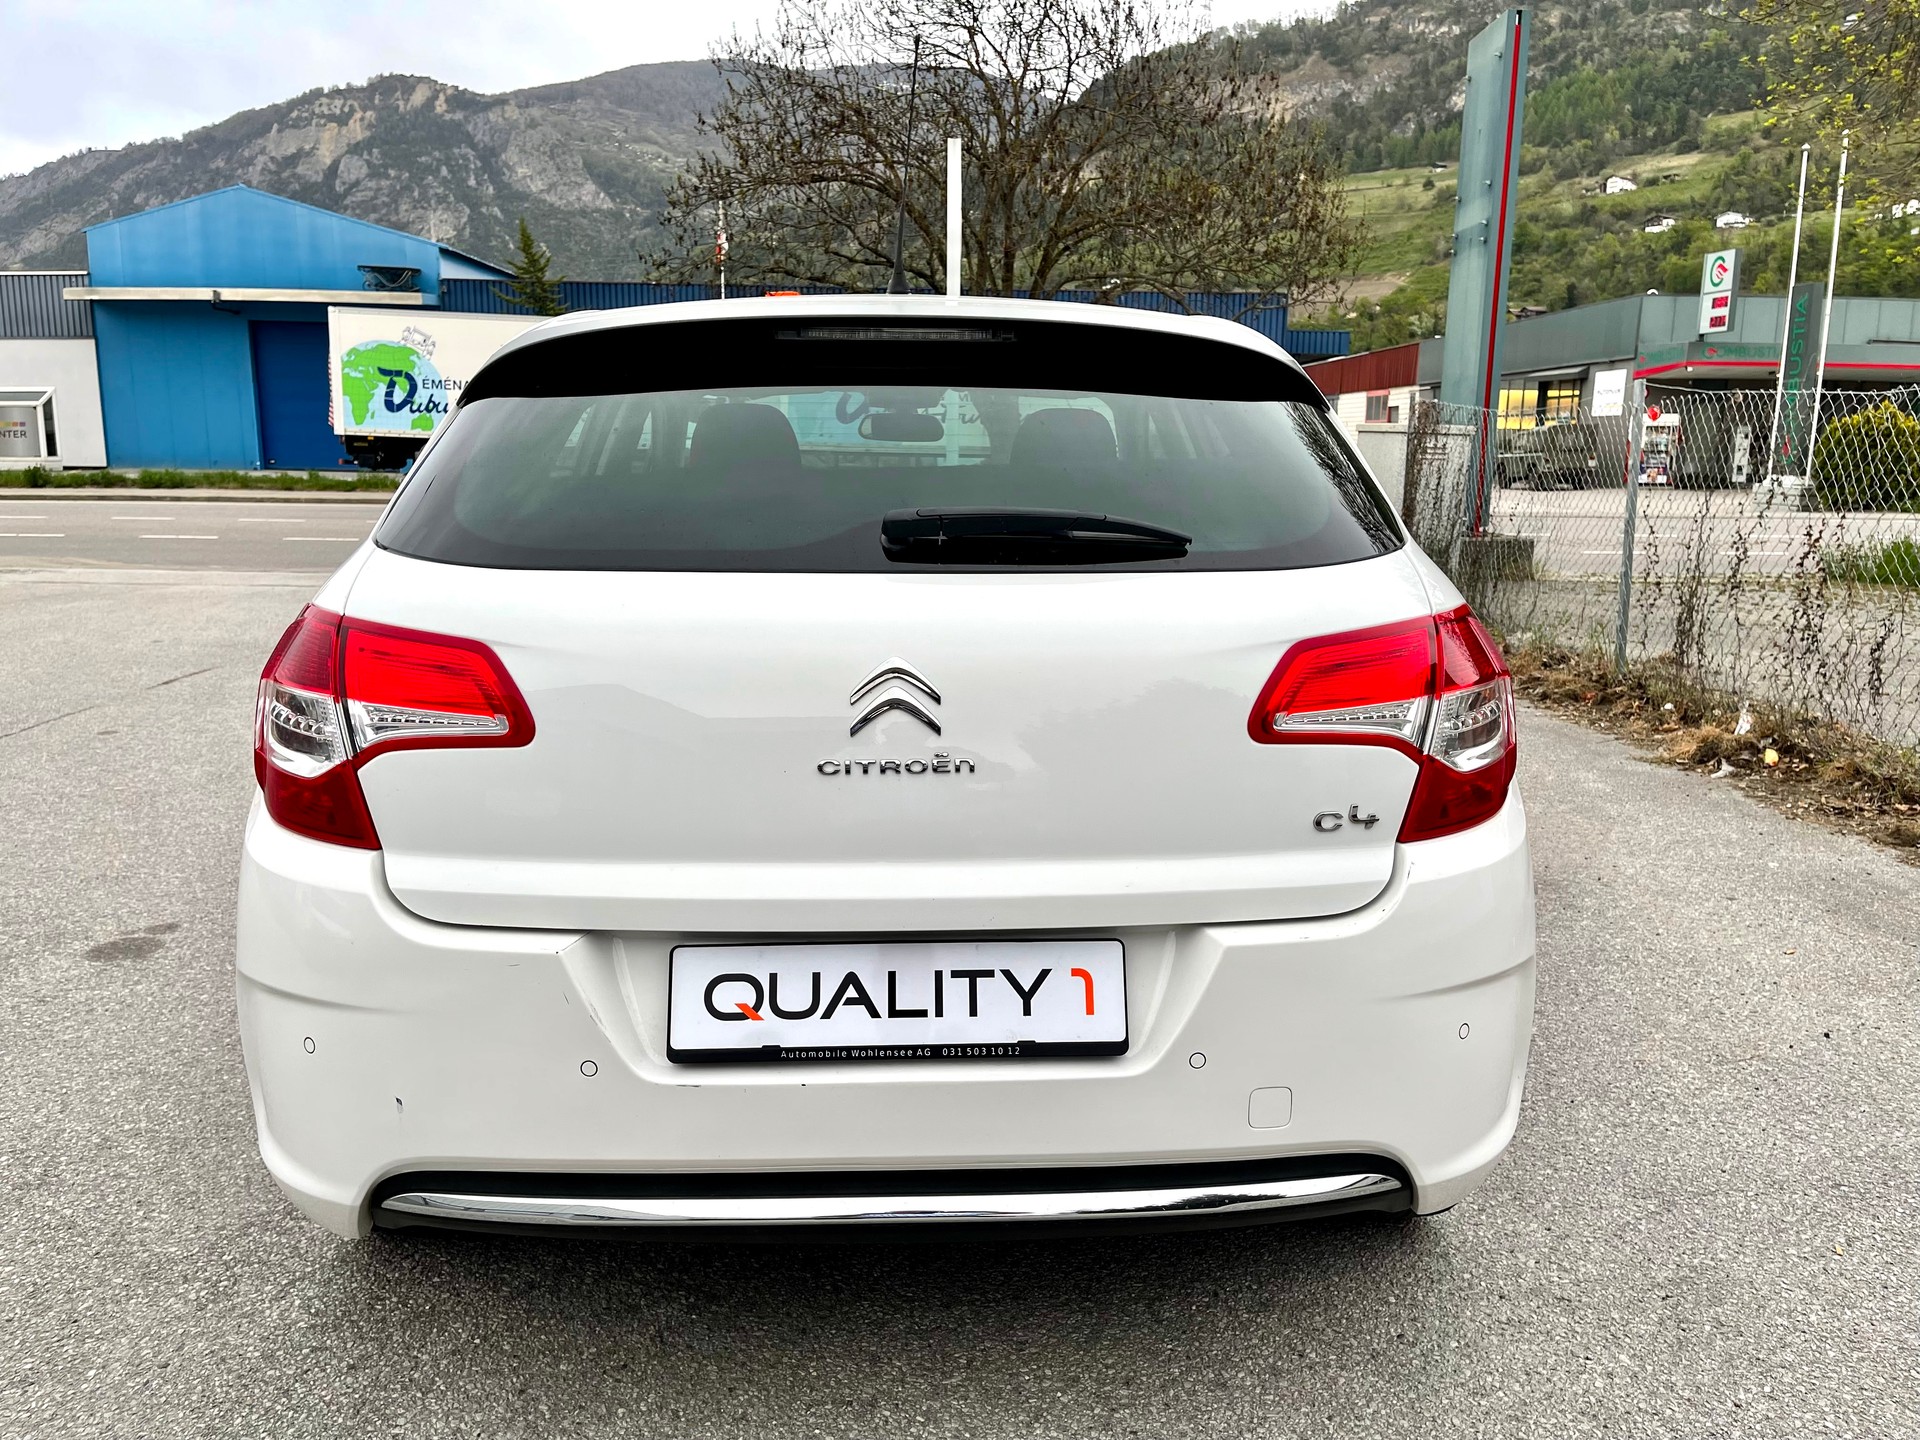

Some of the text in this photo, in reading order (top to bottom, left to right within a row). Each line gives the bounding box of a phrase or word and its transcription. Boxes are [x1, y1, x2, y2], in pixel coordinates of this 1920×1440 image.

[1702, 343, 1780, 360] COMBUSTI
[1312, 803, 1380, 832] C4
[703, 968, 1095, 1022] QUALITY 1
[780, 1046, 1020, 1058] Automobile Wohlensee AG 031 503 10 12
